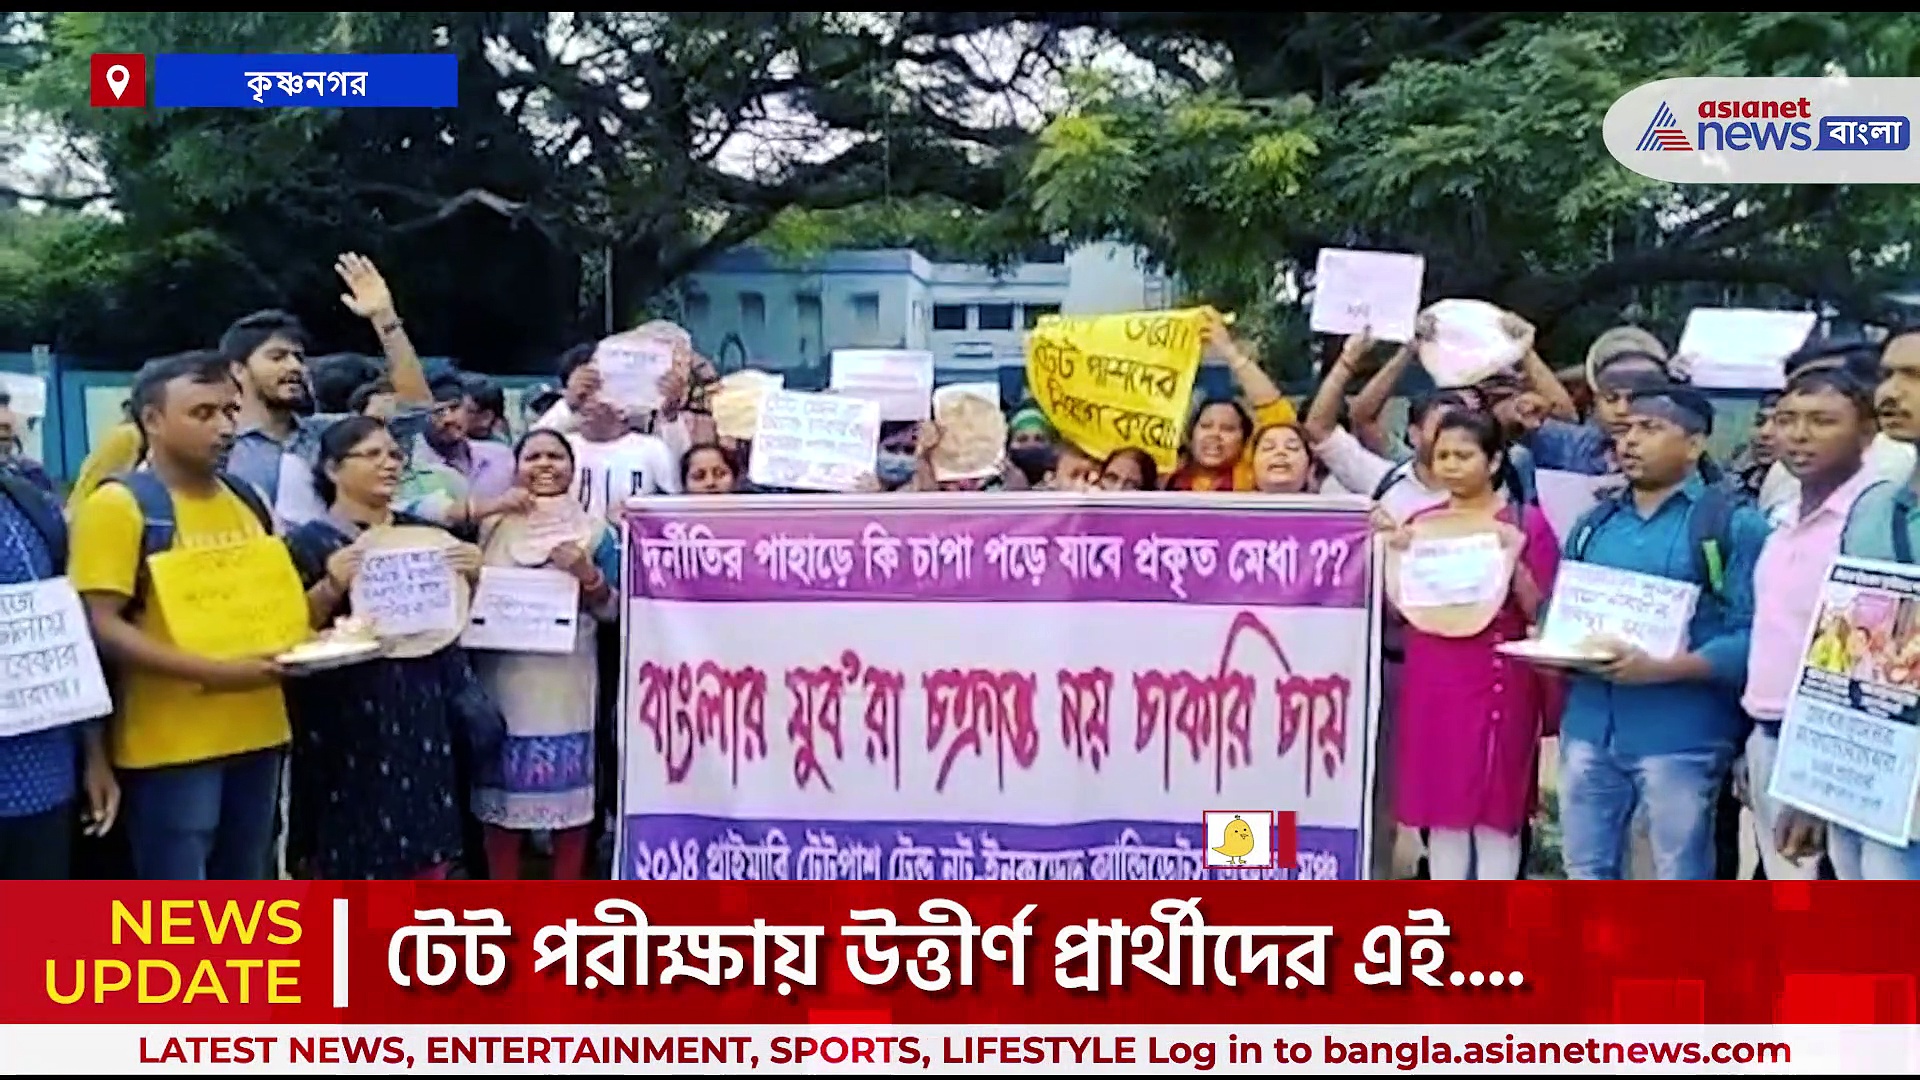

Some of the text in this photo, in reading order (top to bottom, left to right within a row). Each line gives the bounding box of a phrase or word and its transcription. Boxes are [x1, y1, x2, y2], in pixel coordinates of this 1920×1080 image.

[641, 521, 1350, 599] দুর্নীতির পাহাড়ে কি চাপা পড়ে যাবে প্রকৃত মেধা ??
[639, 660, 768, 790] বাংলার
[1058, 667, 1114, 772] নয়
[1132, 611, 1293, 796] চাকরি
[1275, 672, 1352, 798] চায়
